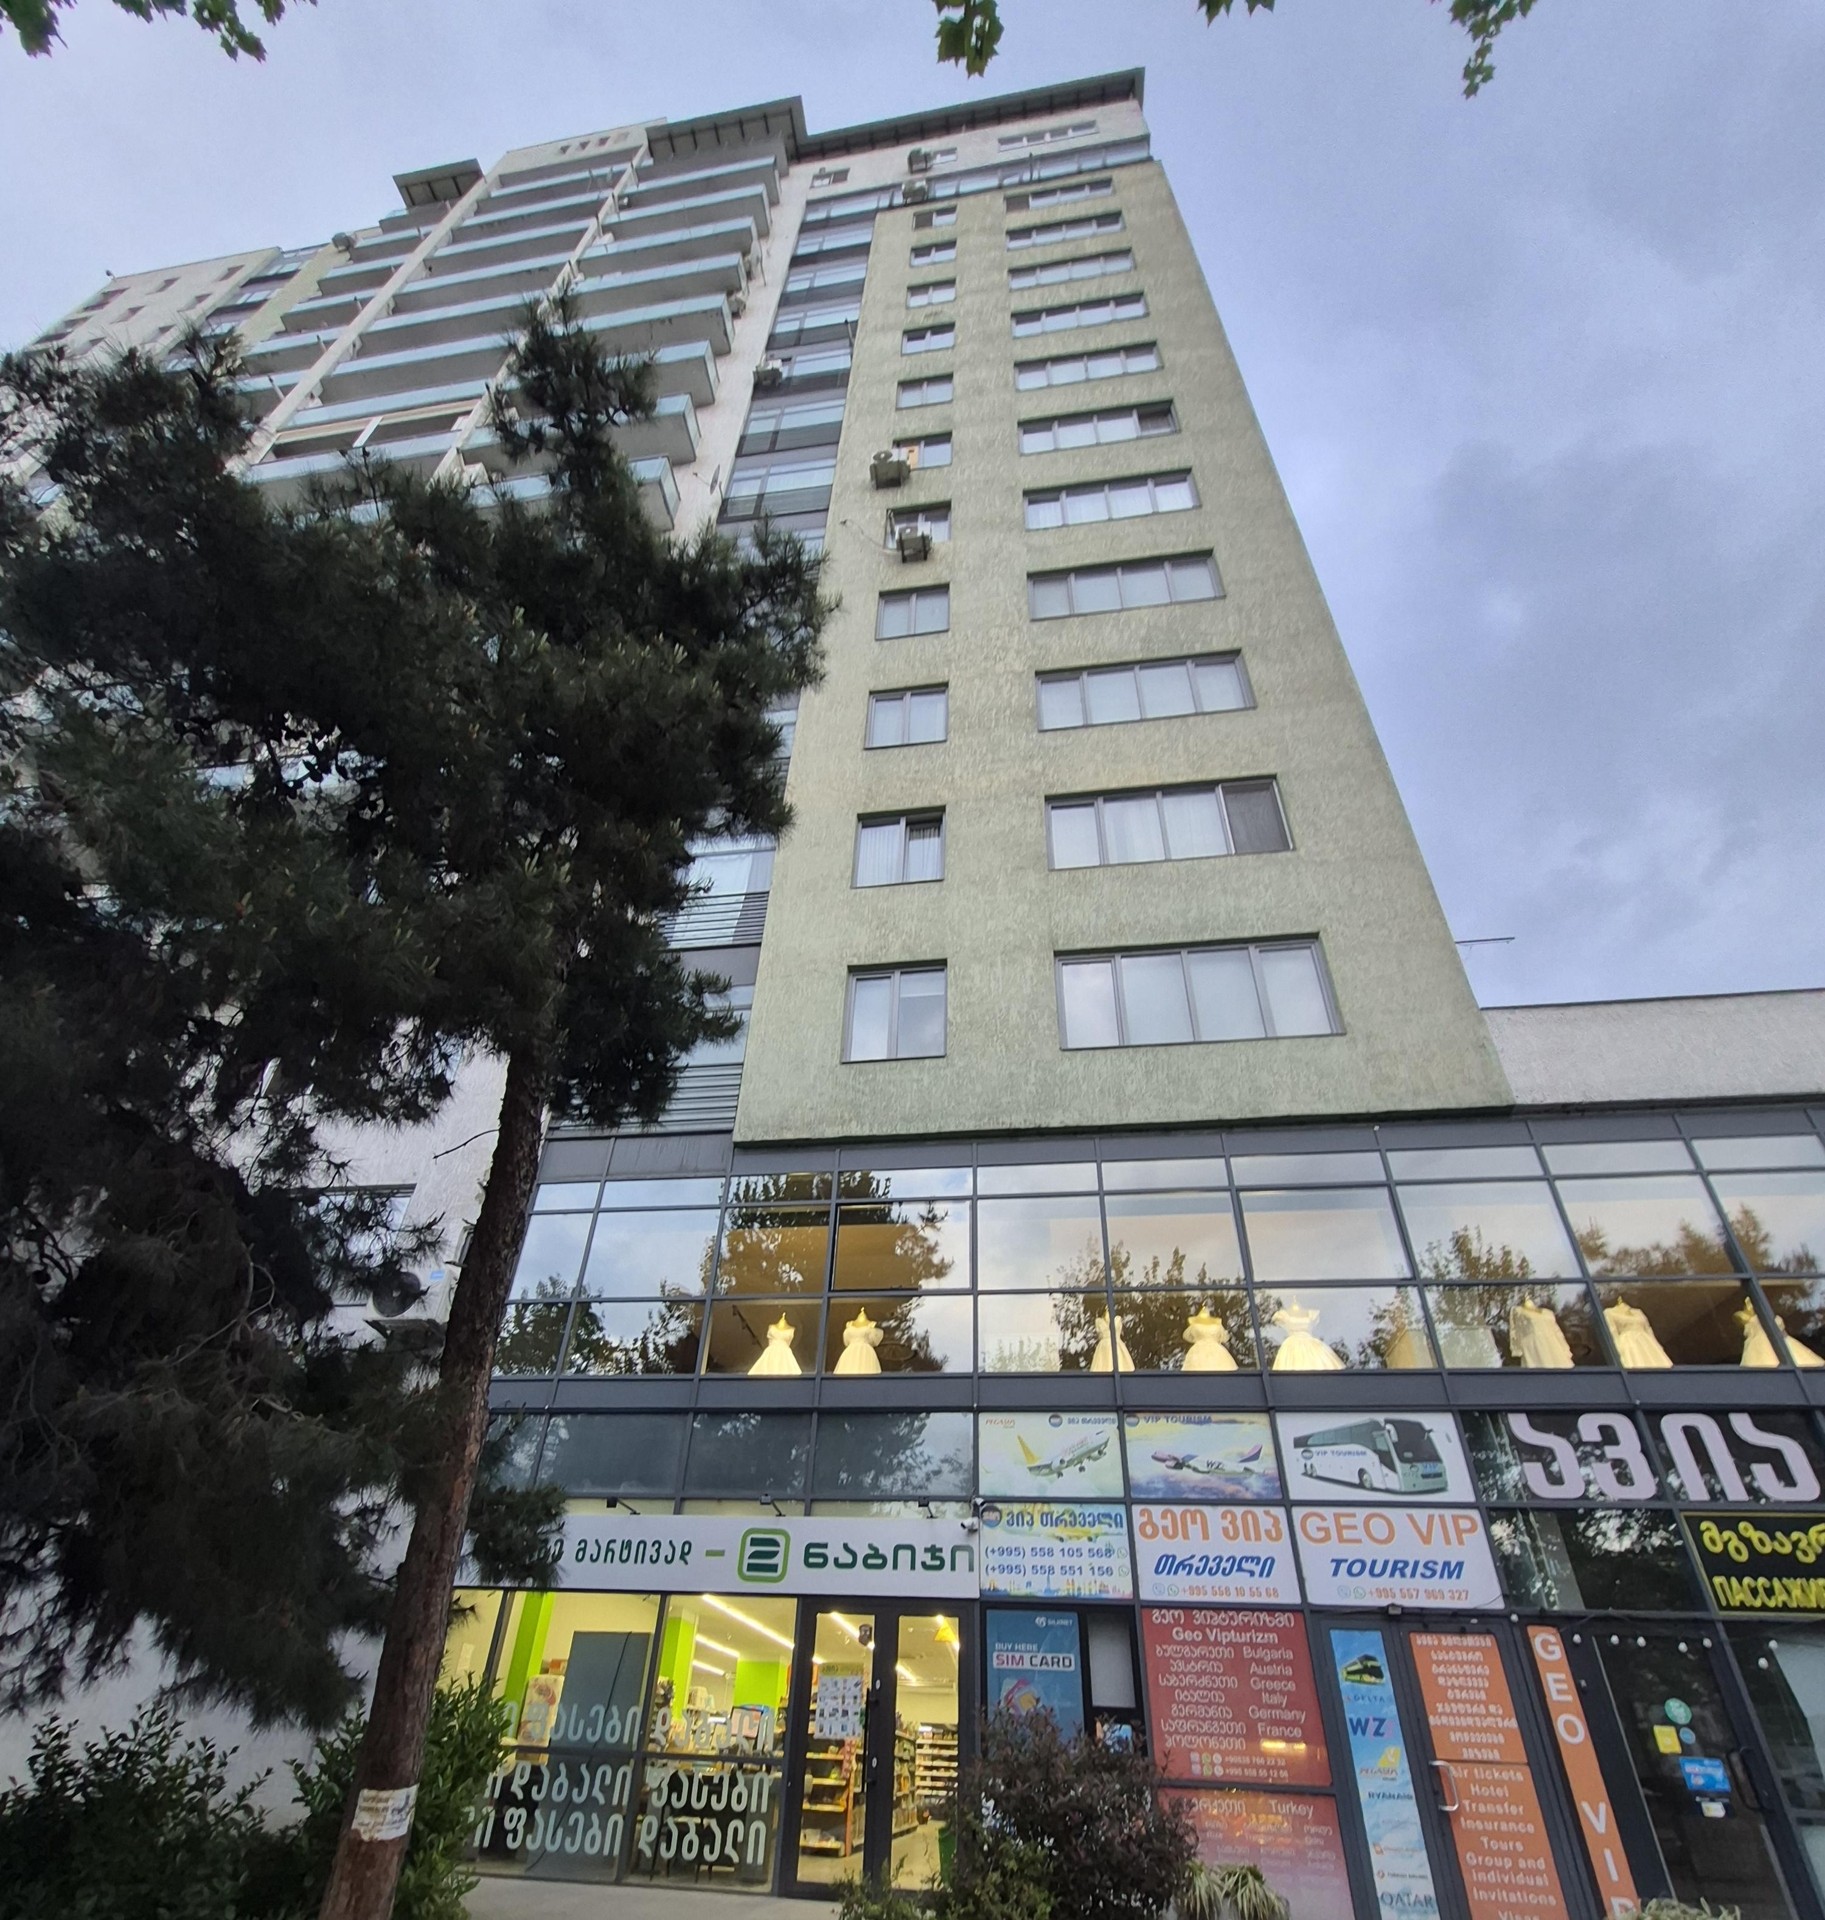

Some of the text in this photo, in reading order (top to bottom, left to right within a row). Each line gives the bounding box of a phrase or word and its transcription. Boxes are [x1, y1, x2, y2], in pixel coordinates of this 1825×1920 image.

[1143, 1415, 1213, 1425] VIP TOURISM
[1508, 1412, 1820, 1500] ავია
[1006, 1511, 1034, 1528] ვიპ
[1040, 1511, 1124, 1529] თრეველი
[1138, 1508, 1283, 1543] გეო ვიპ
[1300, 1511, 1479, 1546] GEO VIP
[575, 1538, 692, 1565] მარტივად
[803, 1542, 975, 1572] ნაბიჯი
[985, 1546, 1026, 1559] (+995)
[1030, 1547, 1054, 1558] 558
[1060, 1547, 1083, 1558] 105
[985, 1564, 1026, 1577] (+995)
[1060, 1566, 1083, 1577] 551
[1154, 1553, 1276, 1578] თრეველი
[1330, 1558, 1465, 1580] TOURISM
[1181, 1585, 1208, 1597] +995
[1235, 1586, 1246, 1598] 10
[1250, 1587, 1262, 1598] 55
[1369, 1587, 1396, 1600] +995
[1152, 1609, 1184, 1624] გეო
[1172, 1627, 1279, 1645] Geo Vipturizm
[995, 1642, 1038, 1652] BUY HERE
[1243, 1646, 1294, 1662] Bulgaria
[996, 1654, 1072, 1668] SIM CARD
[1250, 1662, 1293, 1675] Austria
[1250, 1677, 1296, 1691] Greece
[1534, 1633, 1585, 1745] GEO
[1262, 1692, 1288, 1708] Italy
[1248, 1705, 1306, 1724] Germany
[527, 1703, 643, 1750] ფასები
[1258, 1723, 1302, 1738] France
[1474, 1767, 1524, 1782] tickets
[511, 1761, 633, 1806] დაბალი
[646, 1766, 770, 1813] ფასები
[1470, 1784, 1509, 1798] Hotel
[1270, 1801, 1315, 1819] Turkey
[1462, 1799, 1524, 1816] Transfer
[1460, 1817, 1535, 1834] Insurance
[504, 1807, 624, 1856] ფასები
[638, 1815, 766, 1865] დაბალი
[1480, 1836, 1524, 1852] Tours
[1465, 1851, 1546, 1871] Group and
[1473, 1886, 1557, 1906] Invitations
